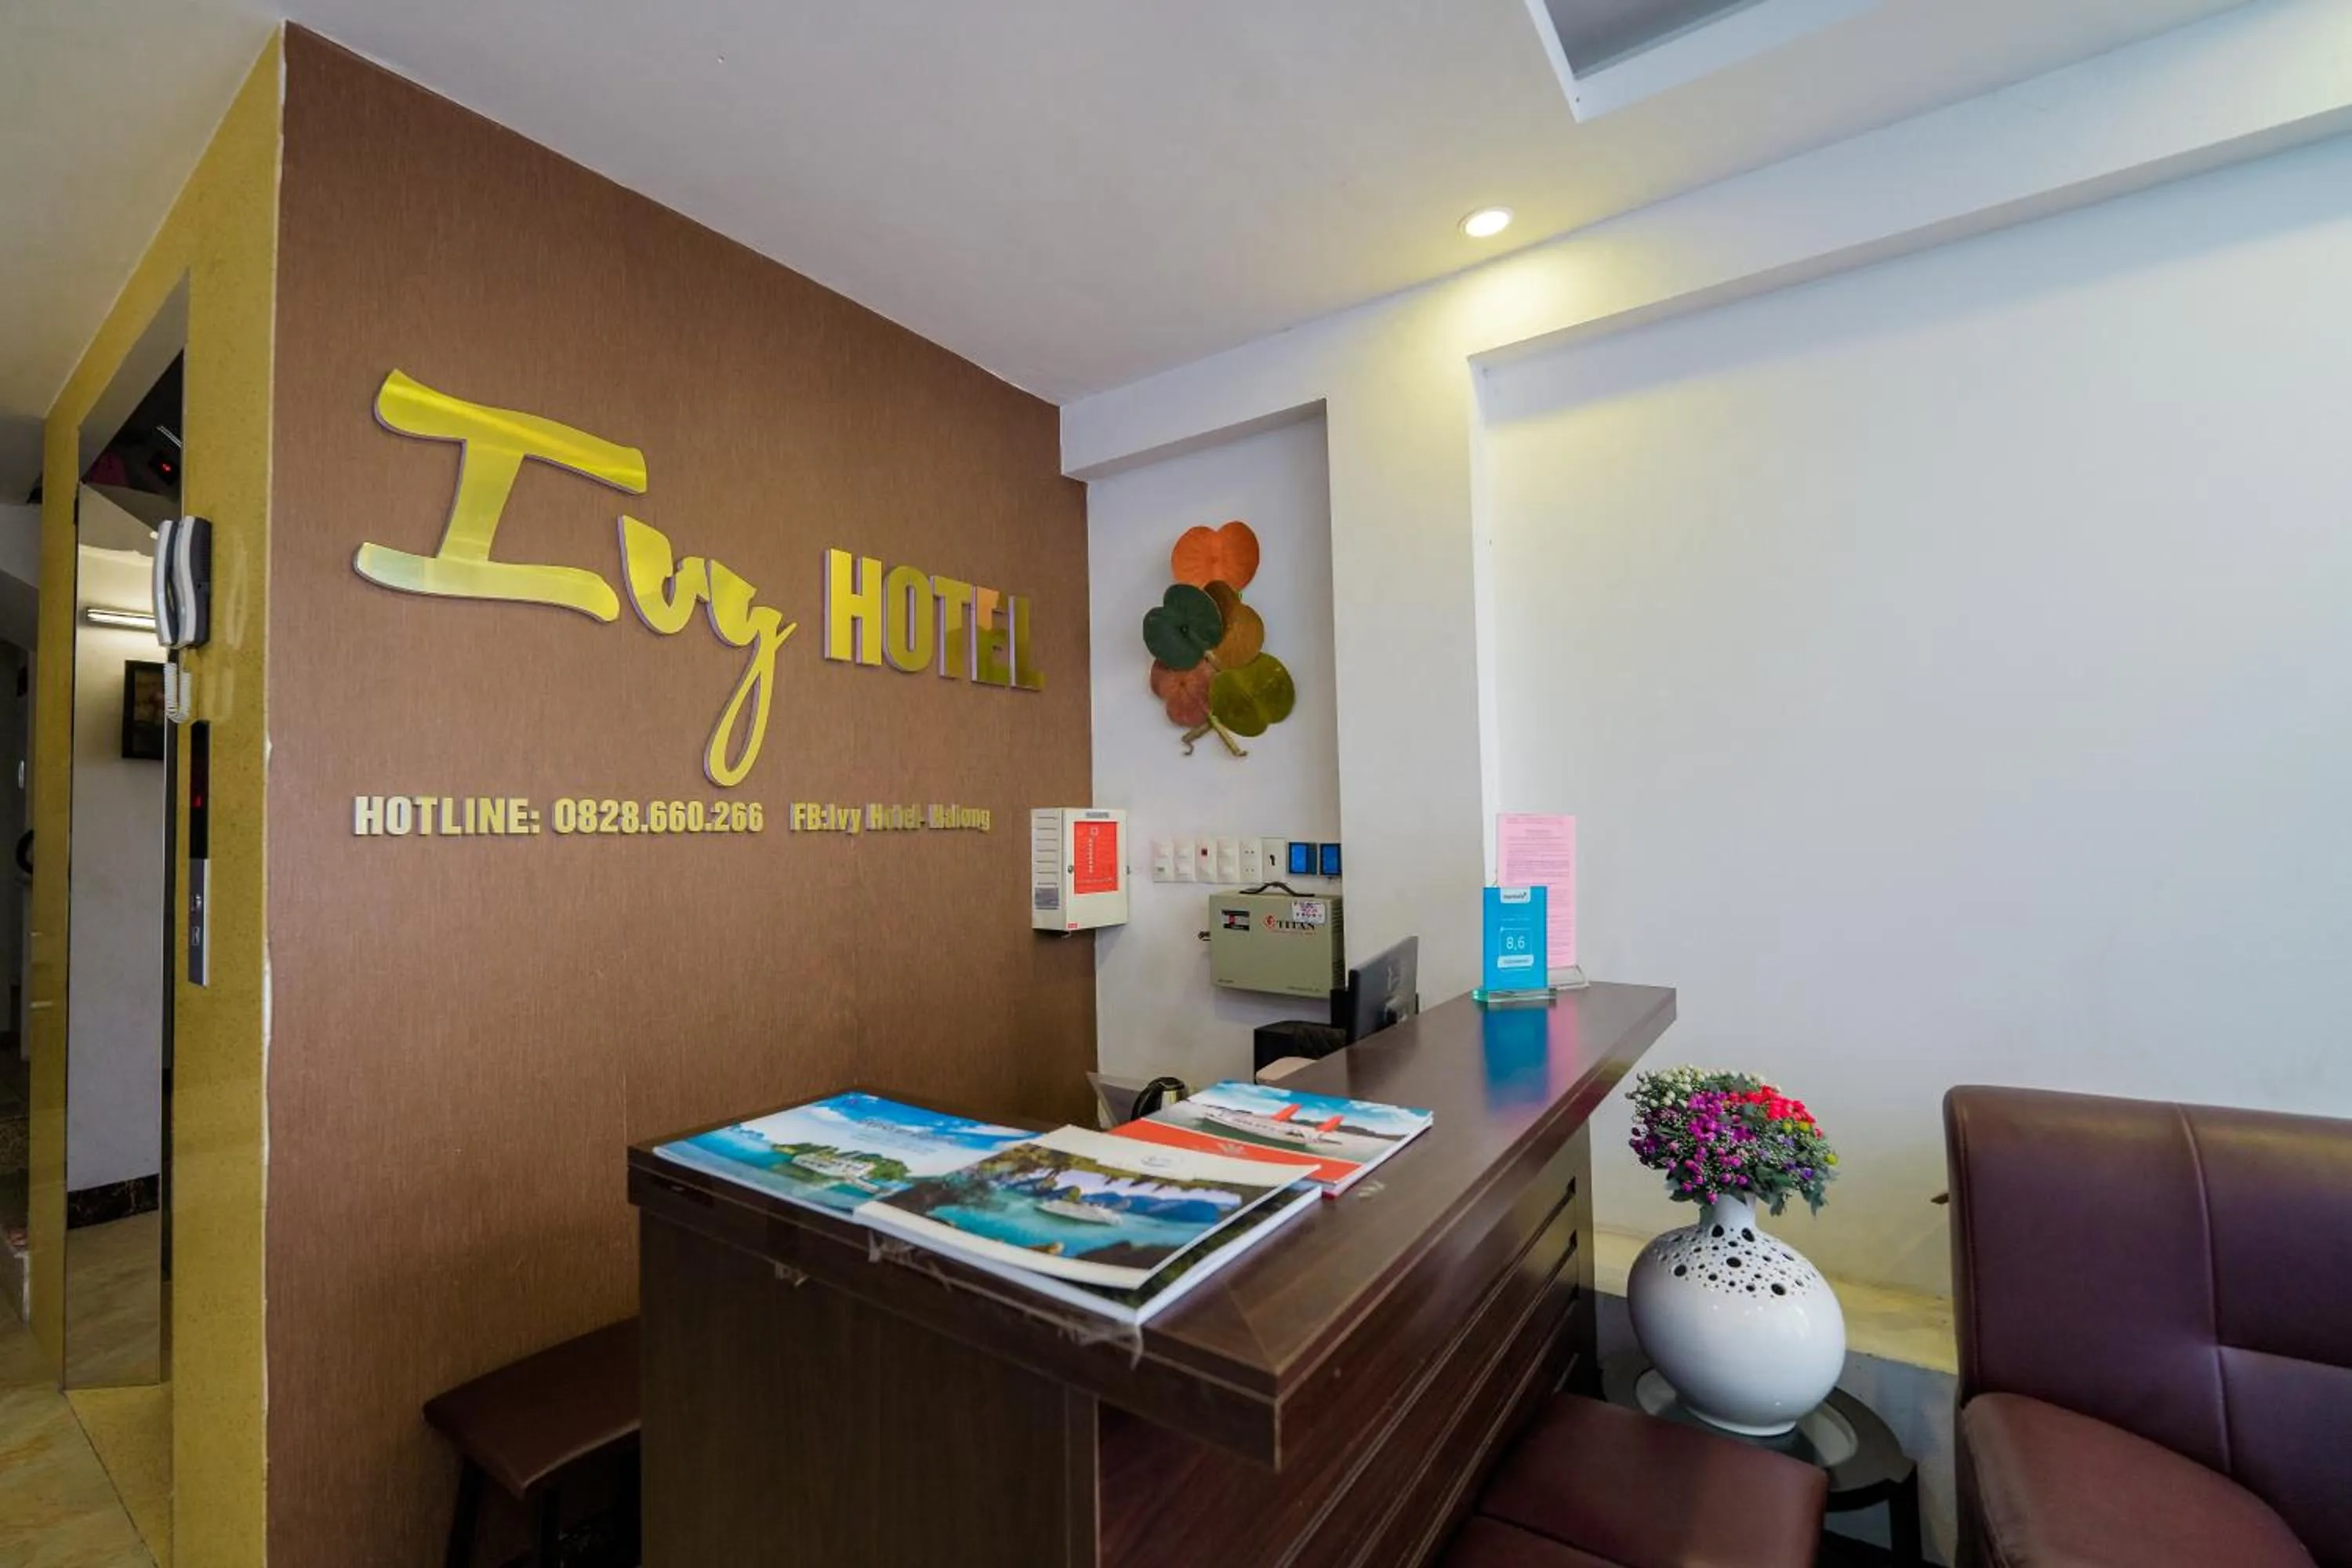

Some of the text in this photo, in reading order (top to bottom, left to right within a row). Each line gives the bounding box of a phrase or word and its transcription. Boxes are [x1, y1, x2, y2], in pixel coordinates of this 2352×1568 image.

[354, 368, 1046, 787] Ivy HOTEL
[353, 796, 764, 836] HOTLINE: 0828.660.266
